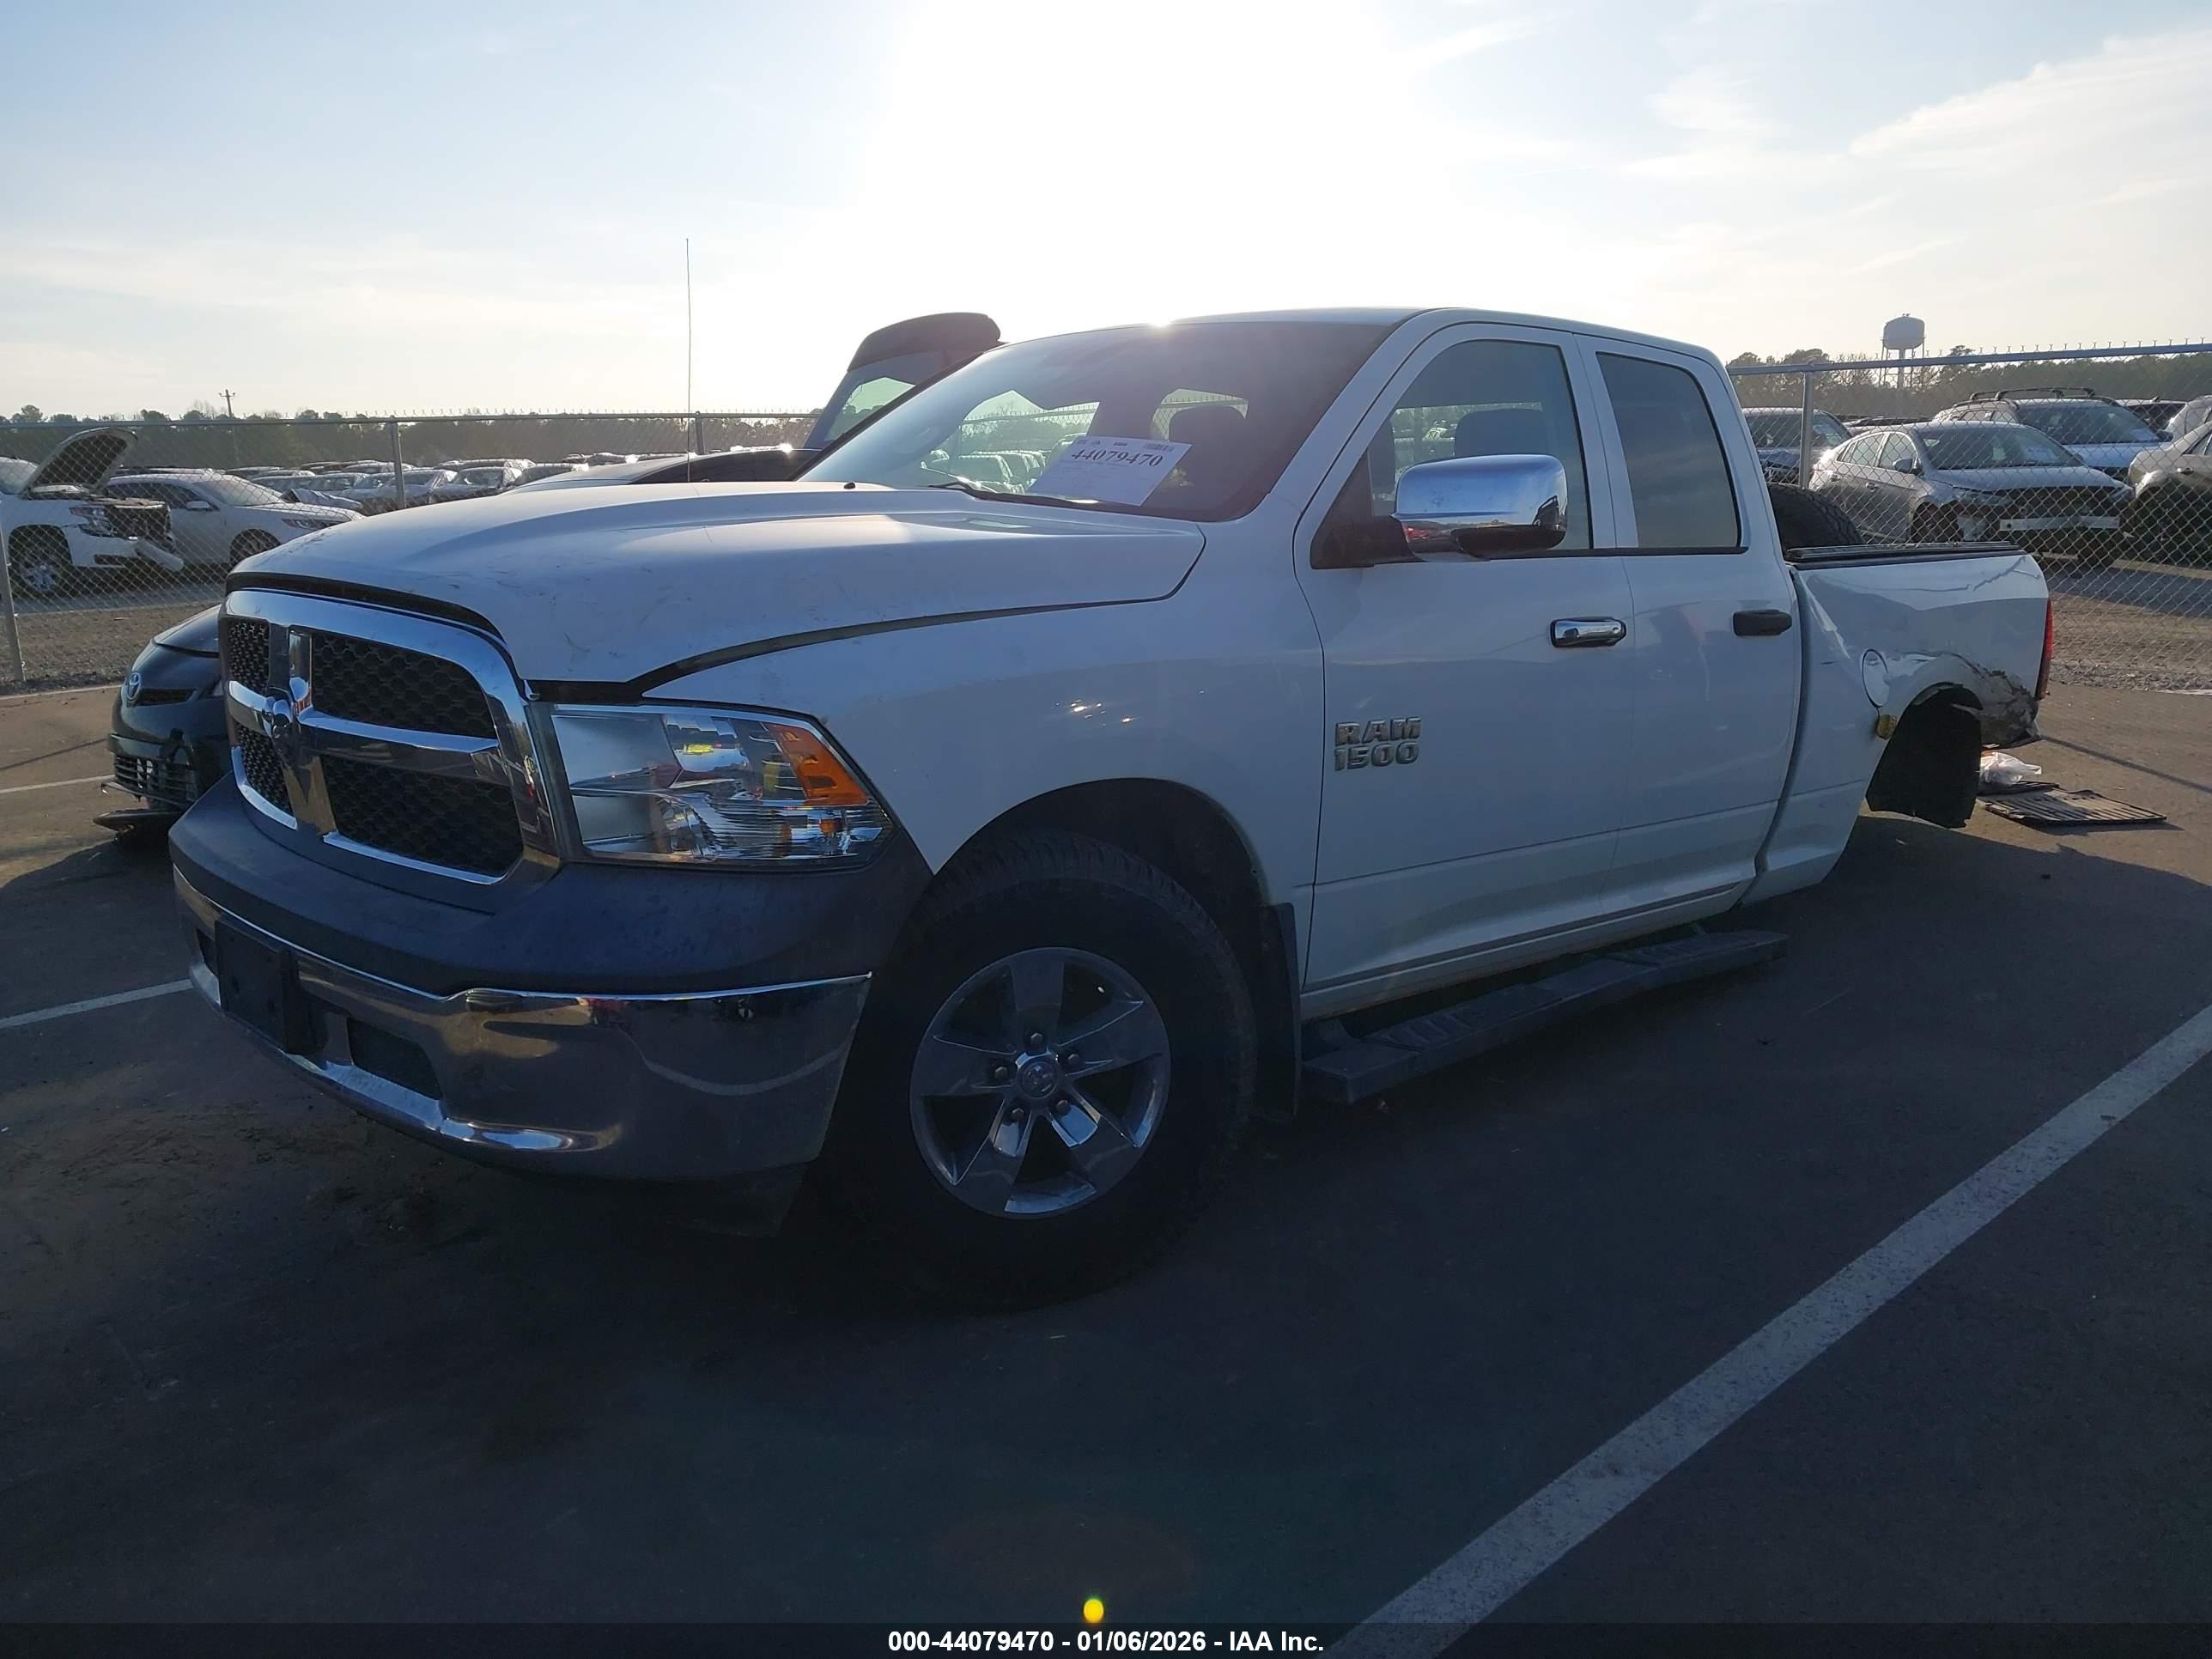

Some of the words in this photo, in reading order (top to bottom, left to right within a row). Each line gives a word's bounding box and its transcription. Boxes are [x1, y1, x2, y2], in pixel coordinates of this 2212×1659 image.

[1072, 448, 1164, 467] 44079470
[1335, 716, 1421, 746] RAM
[1334, 742, 1419, 771] 1500
